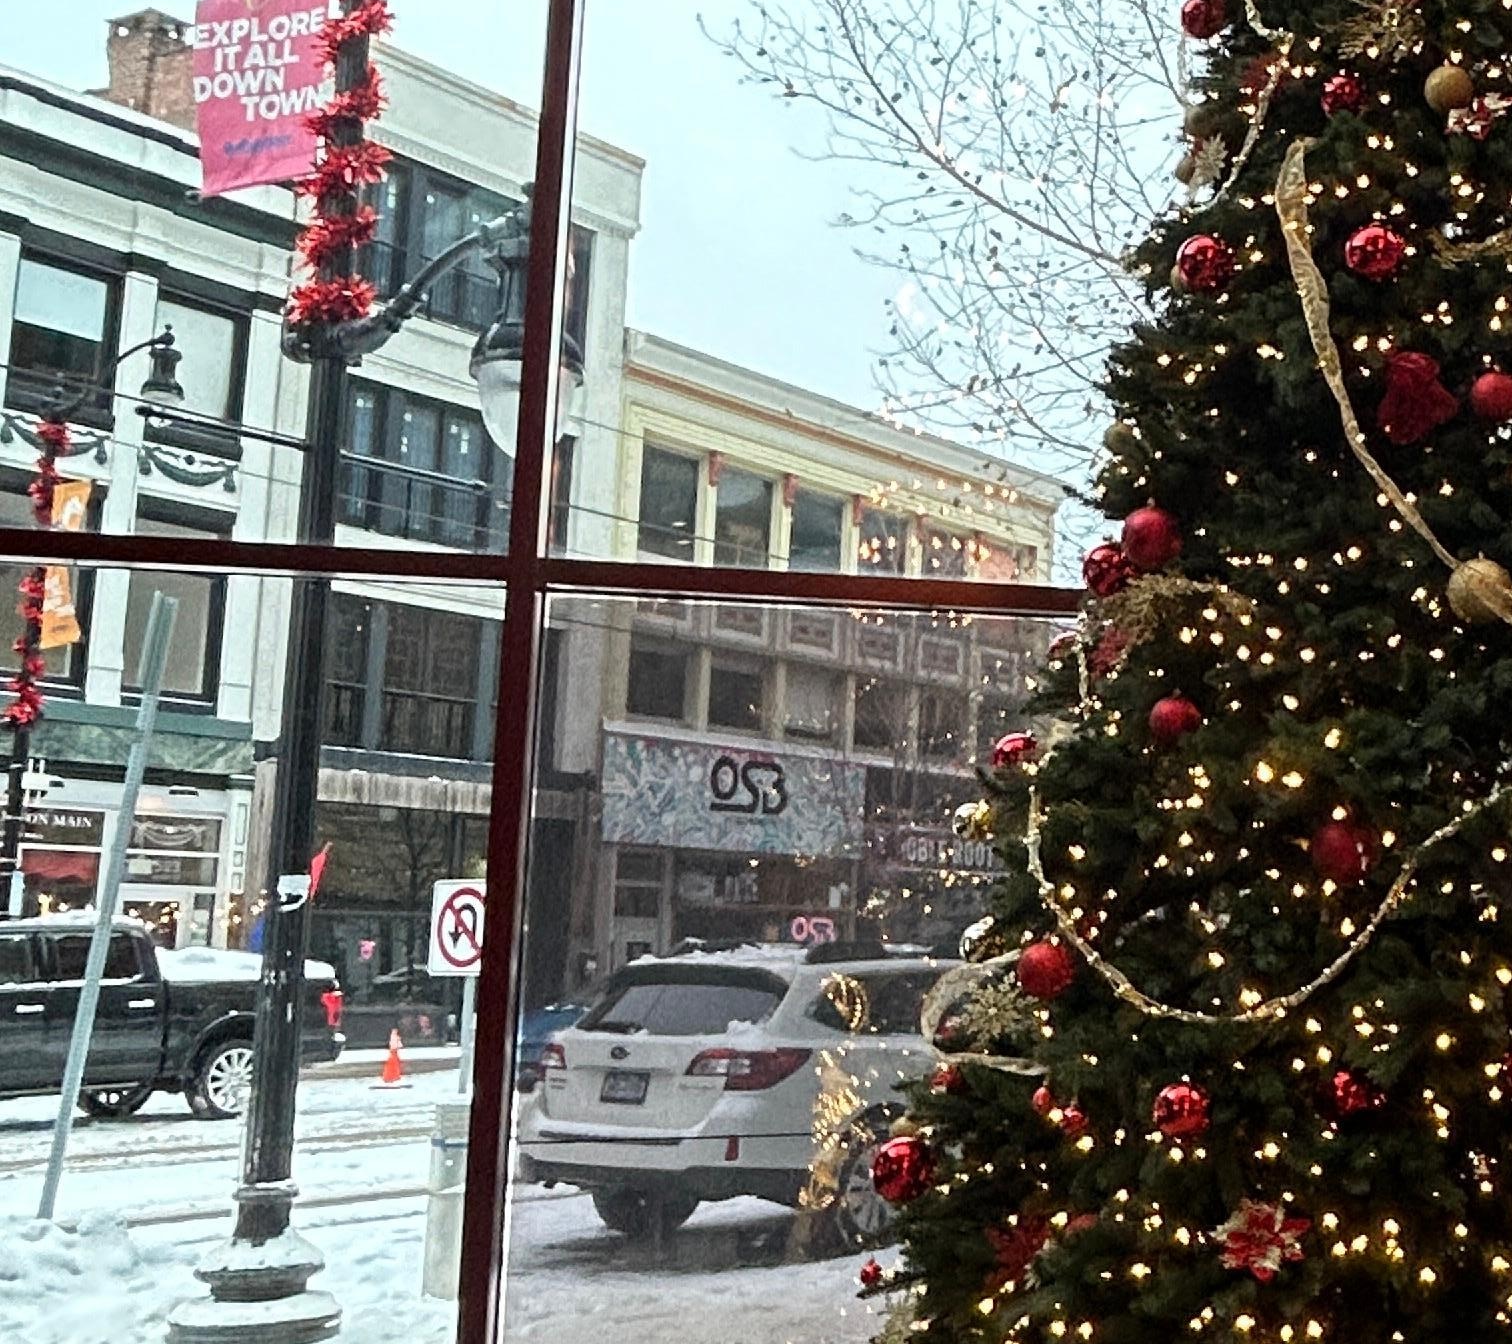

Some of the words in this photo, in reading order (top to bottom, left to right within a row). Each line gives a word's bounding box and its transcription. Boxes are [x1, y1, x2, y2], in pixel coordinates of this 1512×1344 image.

[192, 6, 326, 49] EXPLORE
[214, 45, 242, 72] IT
[243, 39, 300, 68] ALL
[193, 67, 286, 103] DOWN
[240, 84, 325, 122] TOWN
[25, 813, 48, 824] ON
[54, 815, 92, 827] MAIN
